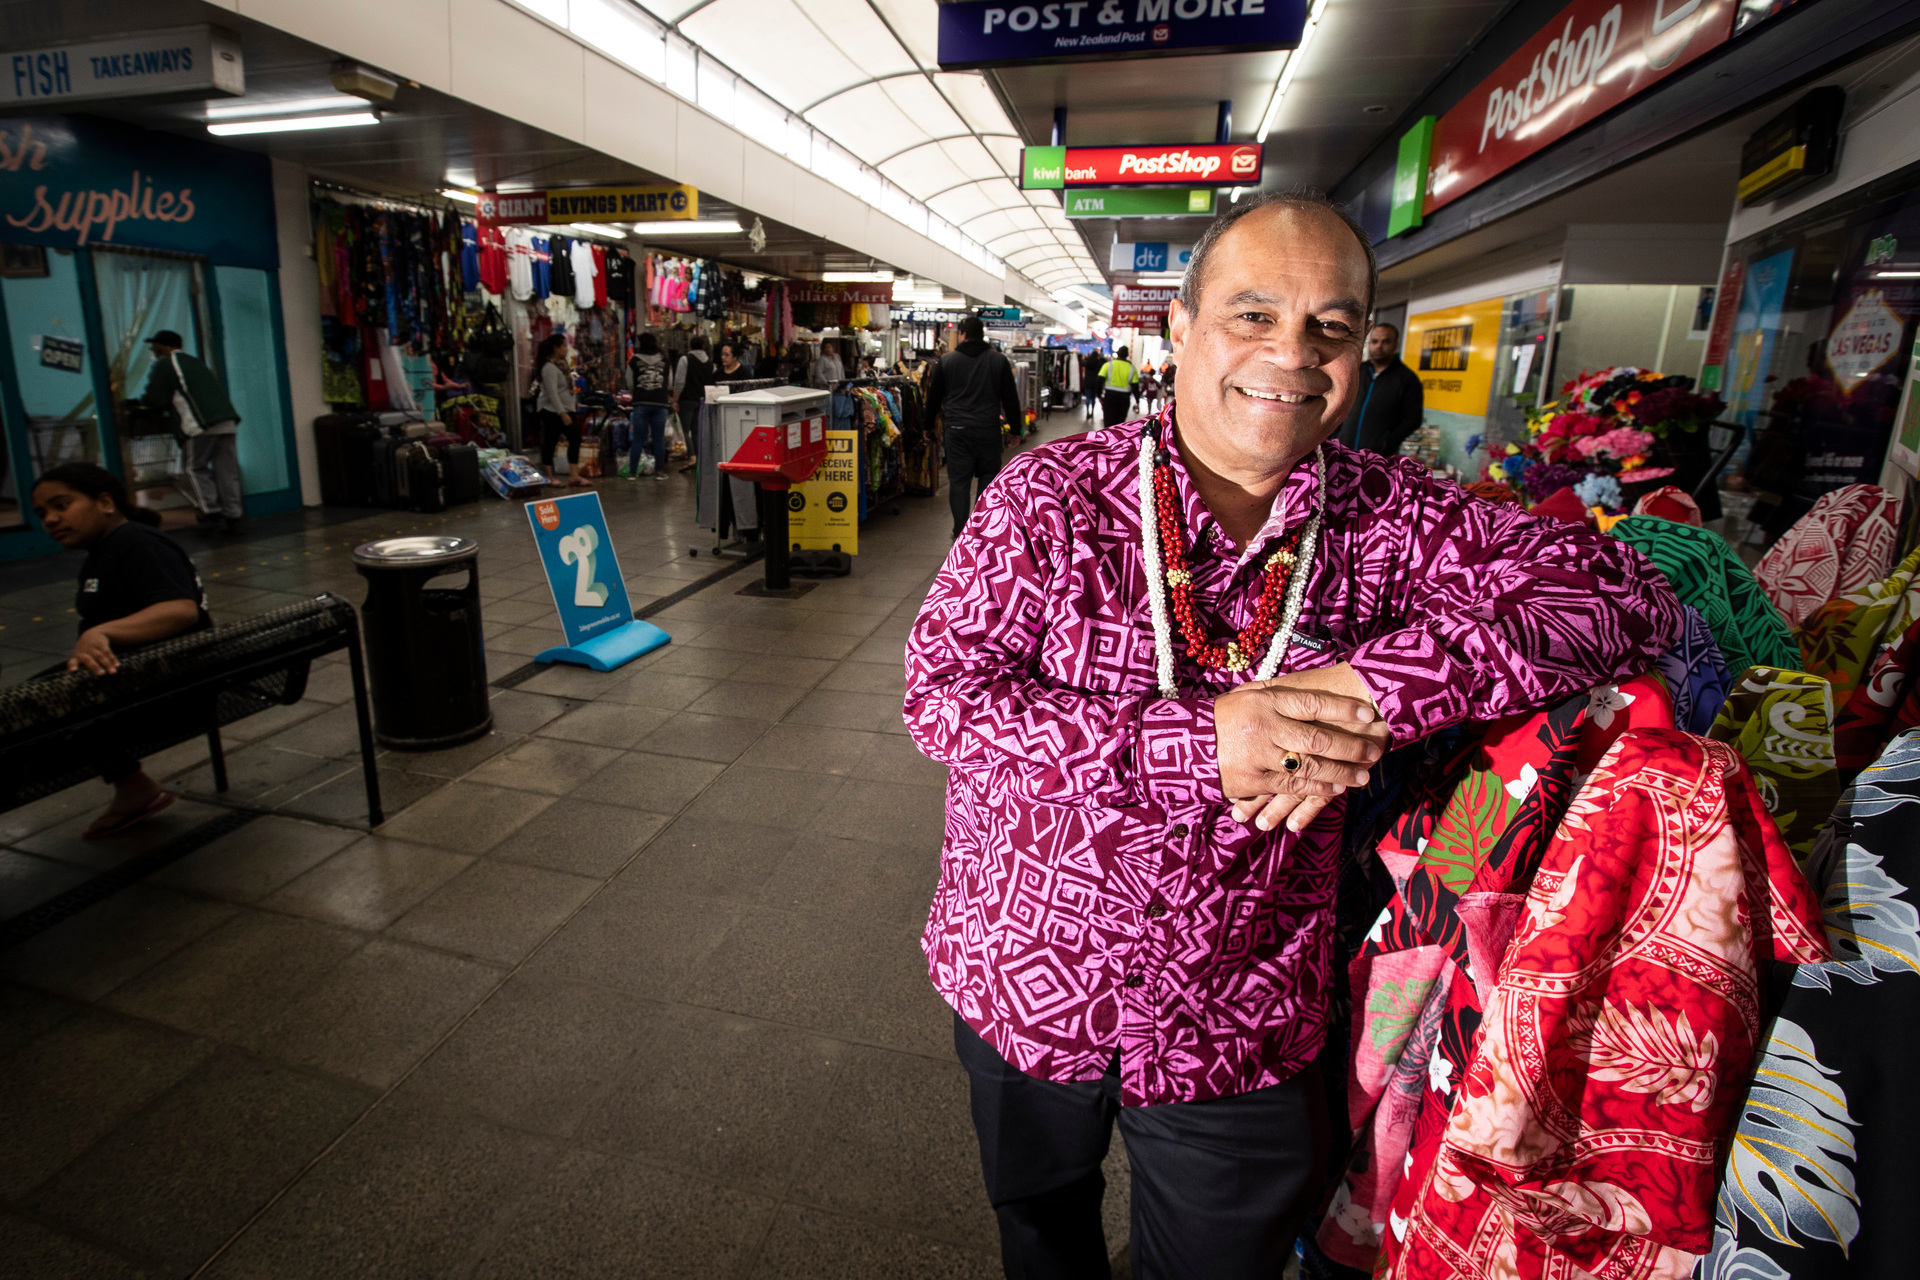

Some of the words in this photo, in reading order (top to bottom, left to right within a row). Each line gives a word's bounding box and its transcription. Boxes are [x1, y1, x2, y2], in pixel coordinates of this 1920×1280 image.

[983, 2, 1089, 34] POST
[1096, 0, 1124, 25] &
[1136, 0, 1266, 22] MORE
[1054, 35, 1077, 48] New
[1079, 33, 1119, 46] Zealand
[1121, 31, 1146, 43] Post
[12, 51, 71, 97] FISH
[90, 47, 193, 79] TAKEAWAYS
[1478, 4, 1622, 154] PostShop
[1032, 167, 1060, 180] kiwi
[1064, 166, 1097, 180] bank
[1119, 151, 1221, 178] PostShop
[6, 170, 196, 247] supplies
[499, 199, 545, 218] GIANT
[549, 196, 618, 215] SAVINGS
[620, 193, 669, 213] MART
[672, 196, 686, 210] 12
[1073, 198, 1105, 212] ATM
[1136, 247, 1162, 268] dtr
[843, 291, 887, 303] Mart
[912, 311, 967, 322] SHOES
[1852, 332, 1892, 355] VEGAS
[42, 348, 81, 369] OPEN
[825, 470, 854, 482] HERE
[539, 504, 555, 515] Sold
[540, 514, 558, 525] Here
[558, 523, 609, 608] 2
[1299, 637, 1322, 650] TANOA
